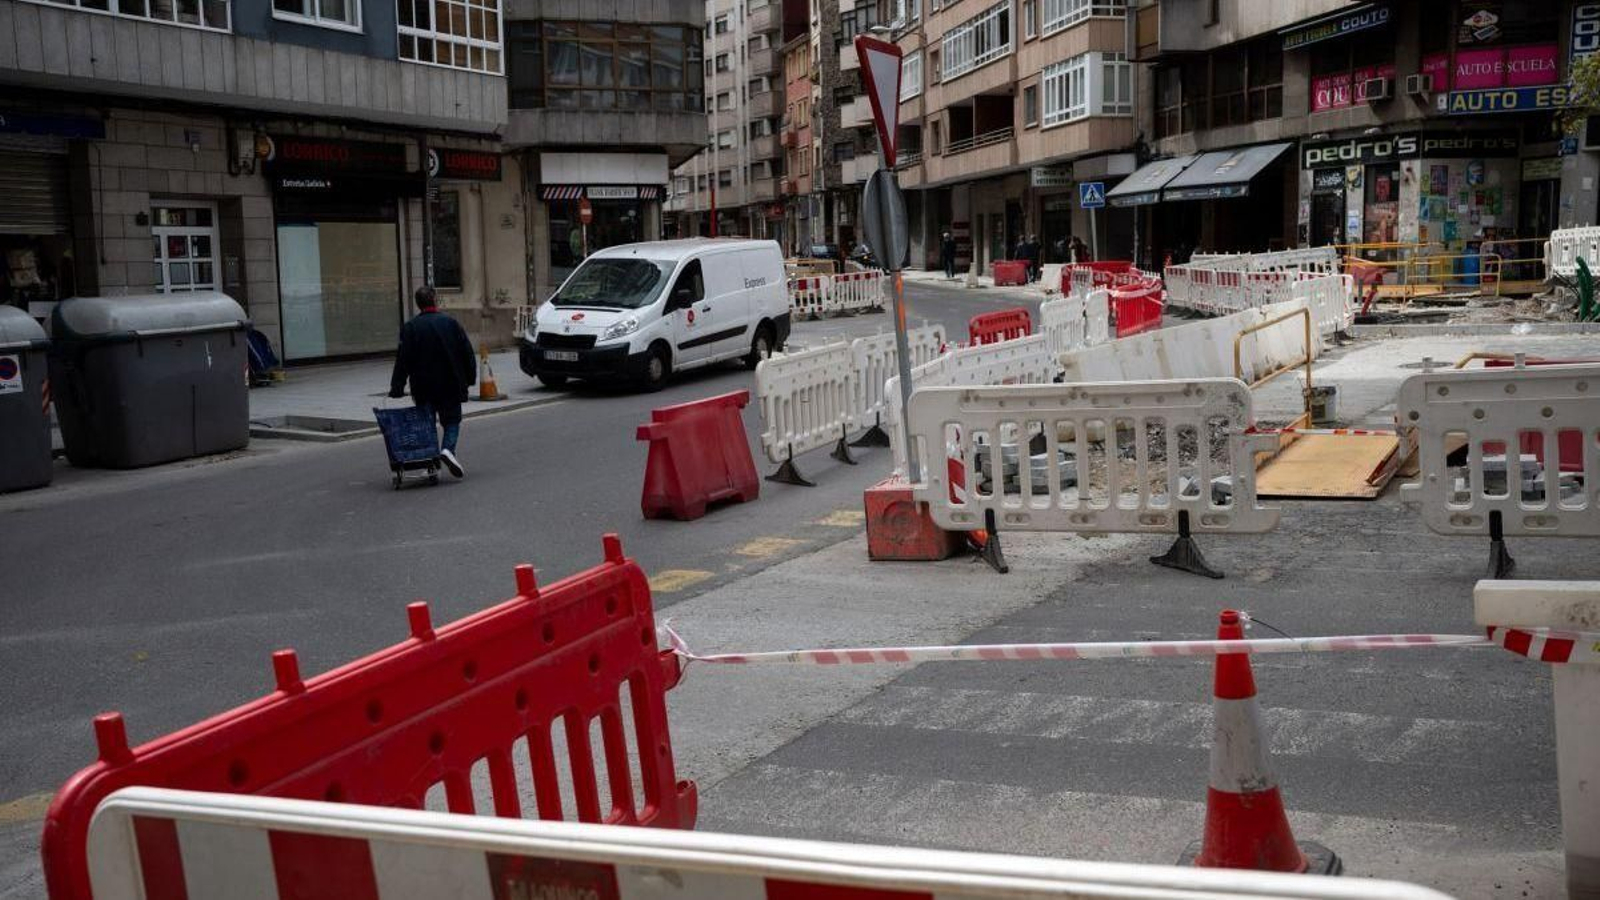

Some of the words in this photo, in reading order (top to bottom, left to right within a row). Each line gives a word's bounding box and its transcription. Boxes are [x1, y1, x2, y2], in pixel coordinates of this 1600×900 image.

[1341, 8, 1390, 31] COUTO
[1456, 63, 1491, 76] AUTO
[1494, 58, 1556, 74] ESCUELA
[1452, 91, 1518, 111] AUTO
[1535, 87, 1568, 106] ES
[1306, 136, 1418, 169] pedro's
[1424, 137, 1517, 153] pedro's
[744, 277, 767, 288] Express
